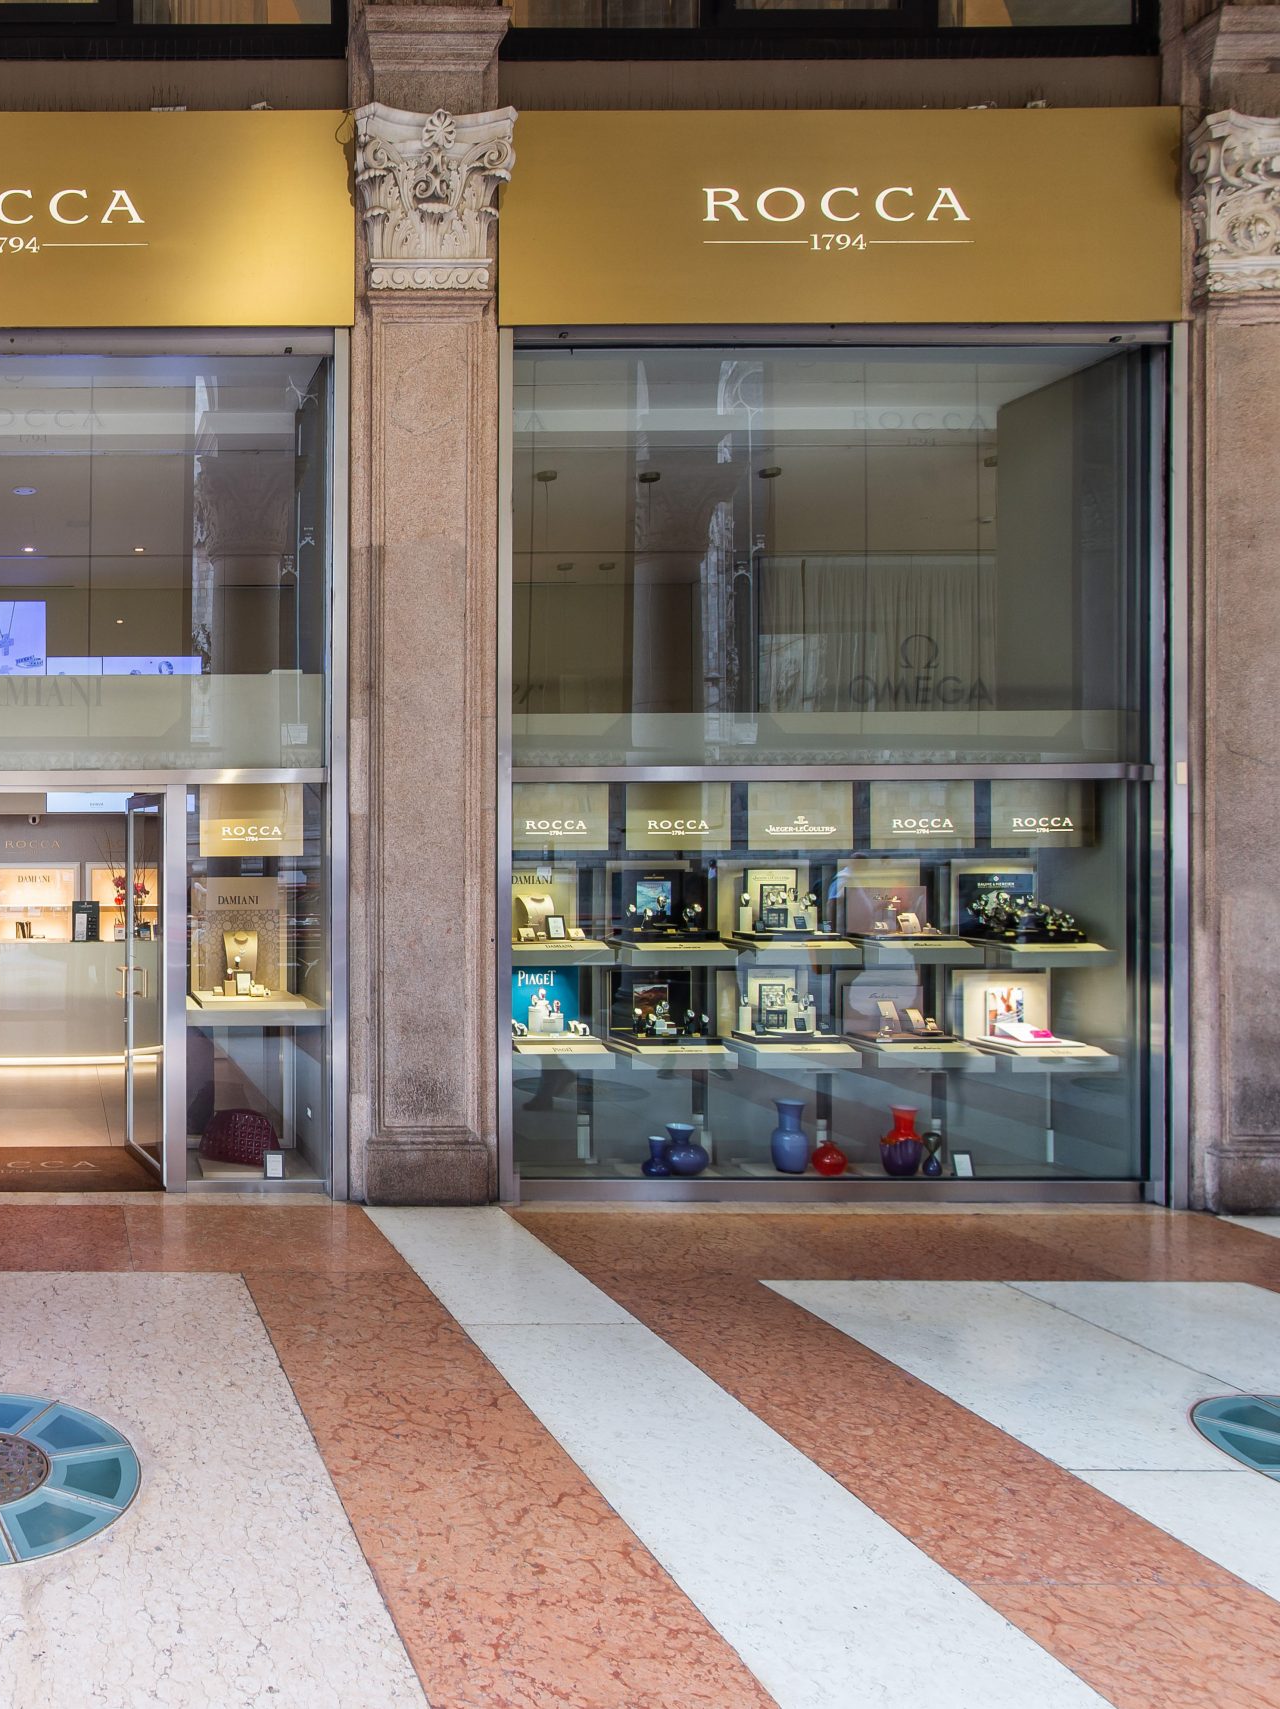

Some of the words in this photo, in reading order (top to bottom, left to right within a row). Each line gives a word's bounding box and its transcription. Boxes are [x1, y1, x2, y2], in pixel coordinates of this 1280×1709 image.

[702, 186, 970, 222] ROCCA
[810, 233, 867, 250] 1794
[850, 409, 989, 432] ROCCA
[849, 675, 994, 705] OMEGA
[525, 820, 587, 830] ROCCA
[648, 820, 709, 830] ROCCA
[892, 819, 953, 828] ROCCA
[1012, 817, 1073, 827] ROCCA
[222, 826, 281, 836] ROCCA
[5, 840, 61, 849] ROCCA
[17, 875, 50, 883] DAMIANI
[512, 875, 553, 885] DAMIANI
[218, 896, 259, 905] DAMIANI
[518, 970, 556, 986] PIAGET
